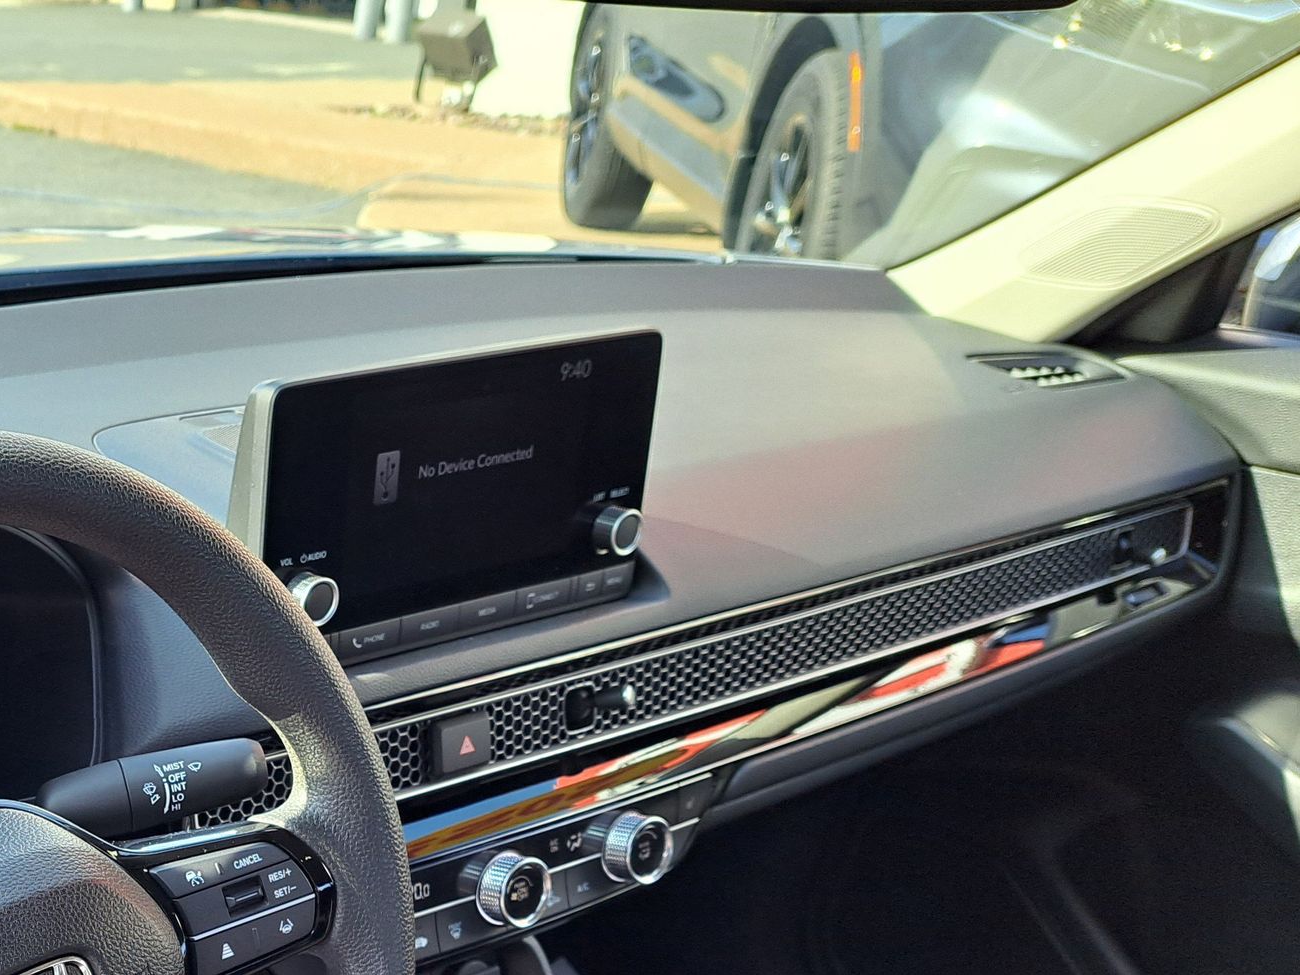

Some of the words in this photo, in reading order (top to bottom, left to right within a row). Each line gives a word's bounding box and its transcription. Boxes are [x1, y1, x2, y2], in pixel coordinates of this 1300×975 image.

[560, 359, 592, 382] 9:40
[418, 464, 435, 479] No
[438, 459, 475, 476] Device
[477, 445, 534, 467] Connected
[162, 760, 185, 774] MIST
[168, 771, 187, 783] OFF
[171, 781, 187, 793] INT
[172, 794, 185, 803] LO
[171, 803, 181, 812] HI
[233, 853, 263, 870] CANCEL
[268, 868, 292, 883] RES/+
[273, 886, 297, 899] SET/-
